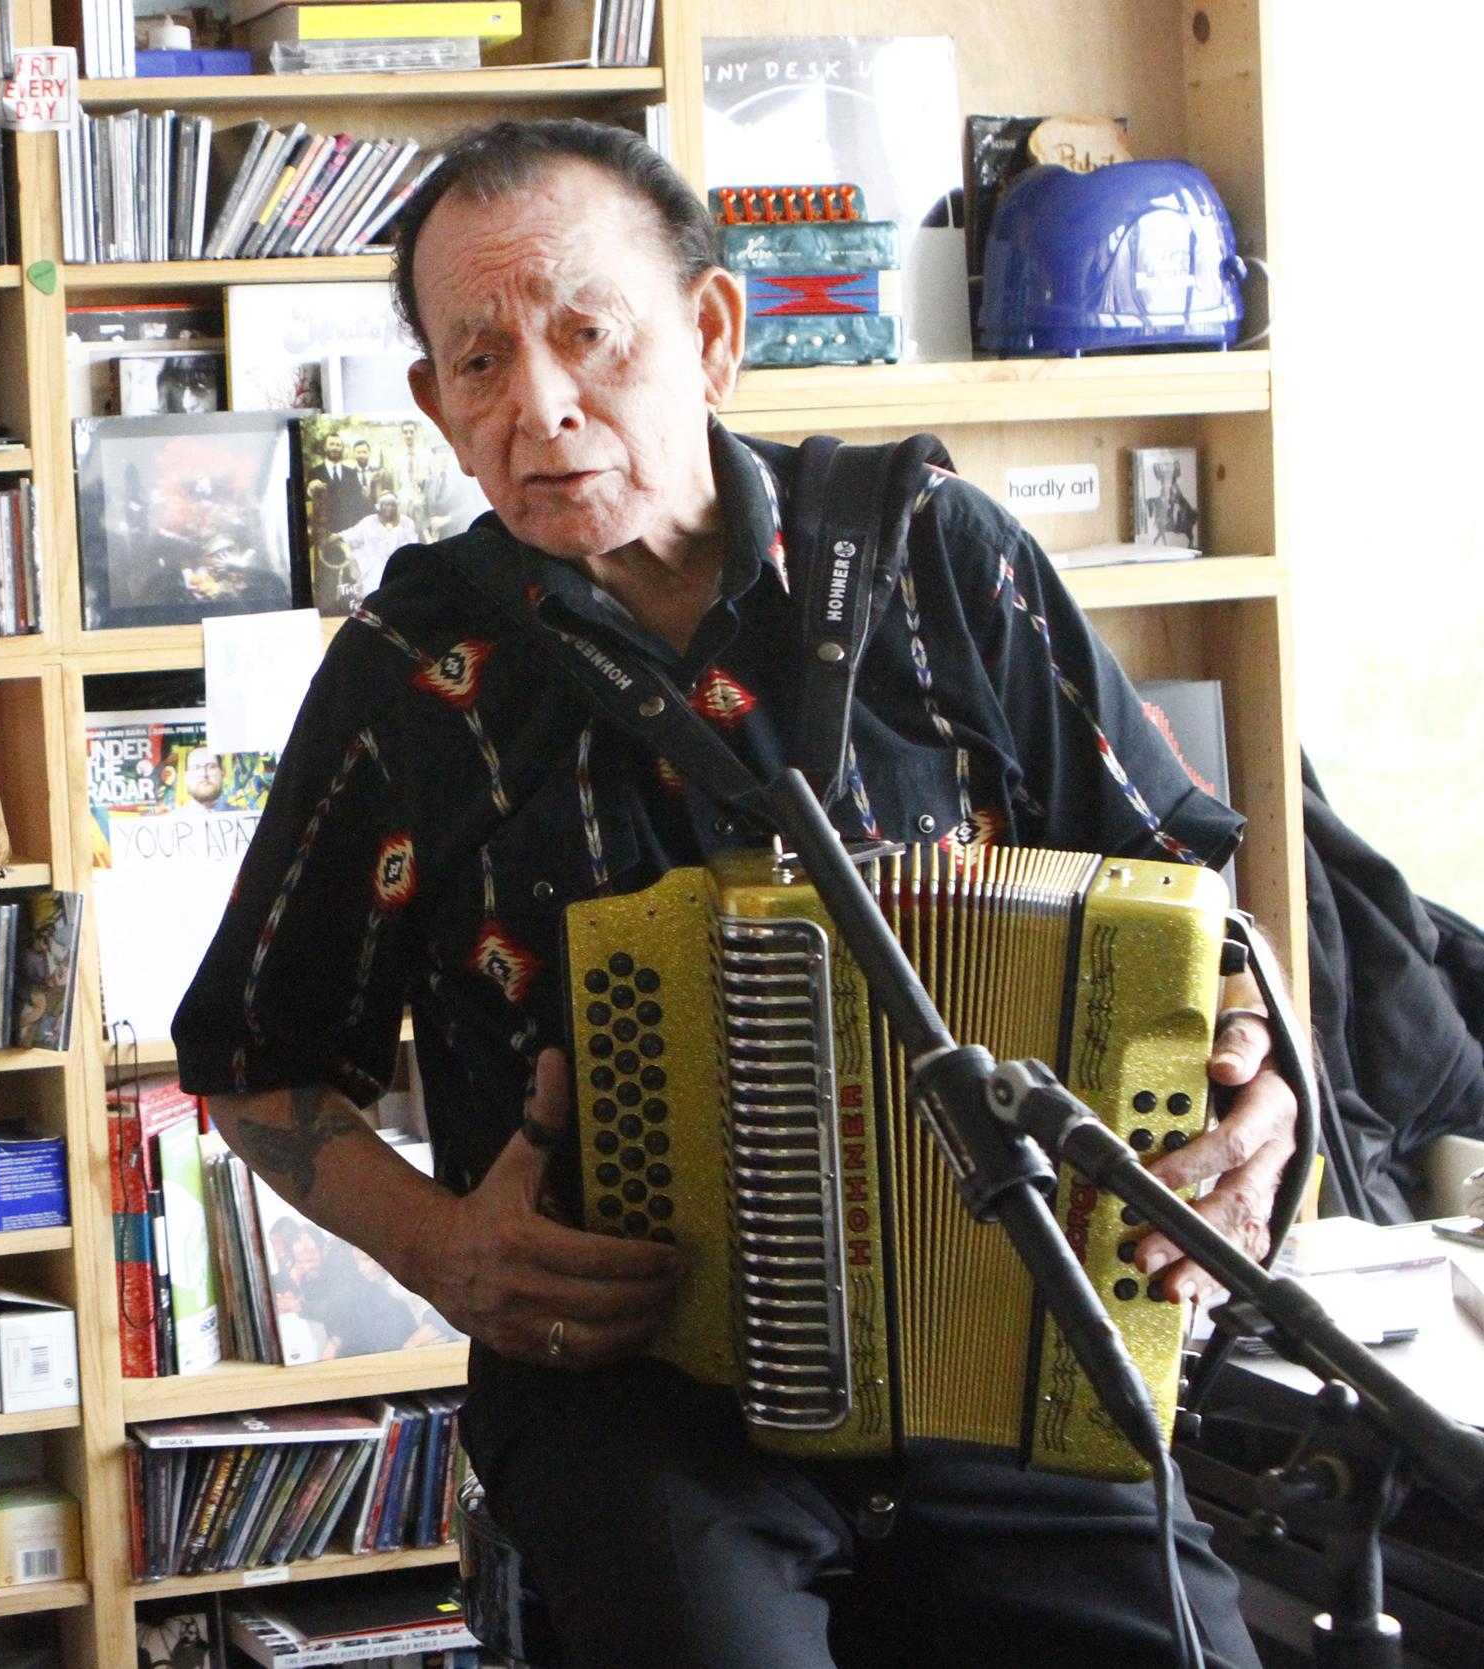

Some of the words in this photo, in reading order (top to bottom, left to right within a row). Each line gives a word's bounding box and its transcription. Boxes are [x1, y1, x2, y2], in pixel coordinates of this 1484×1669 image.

[16, 56, 58, 77] ART
[765, 60, 842, 80] DESK
[3, 78, 68, 99] EVERY
[15, 100, 57, 121] DAY
[1051, 141, 1116, 174] Pabt
[1008, 478, 1066, 500] hardly
[1070, 476, 1095, 496] art
[826, 558, 851, 622] HOHNER
[574, 639, 634, 691] HOHNER
[87, 738, 153, 761] UNDER
[87, 759, 125, 782] THE
[87, 778, 156, 802] RADAR
[116, 821, 196, 862] YOUR
[840, 1084, 872, 1266] HOHNER
[285, 1657, 299, 1666] THE
